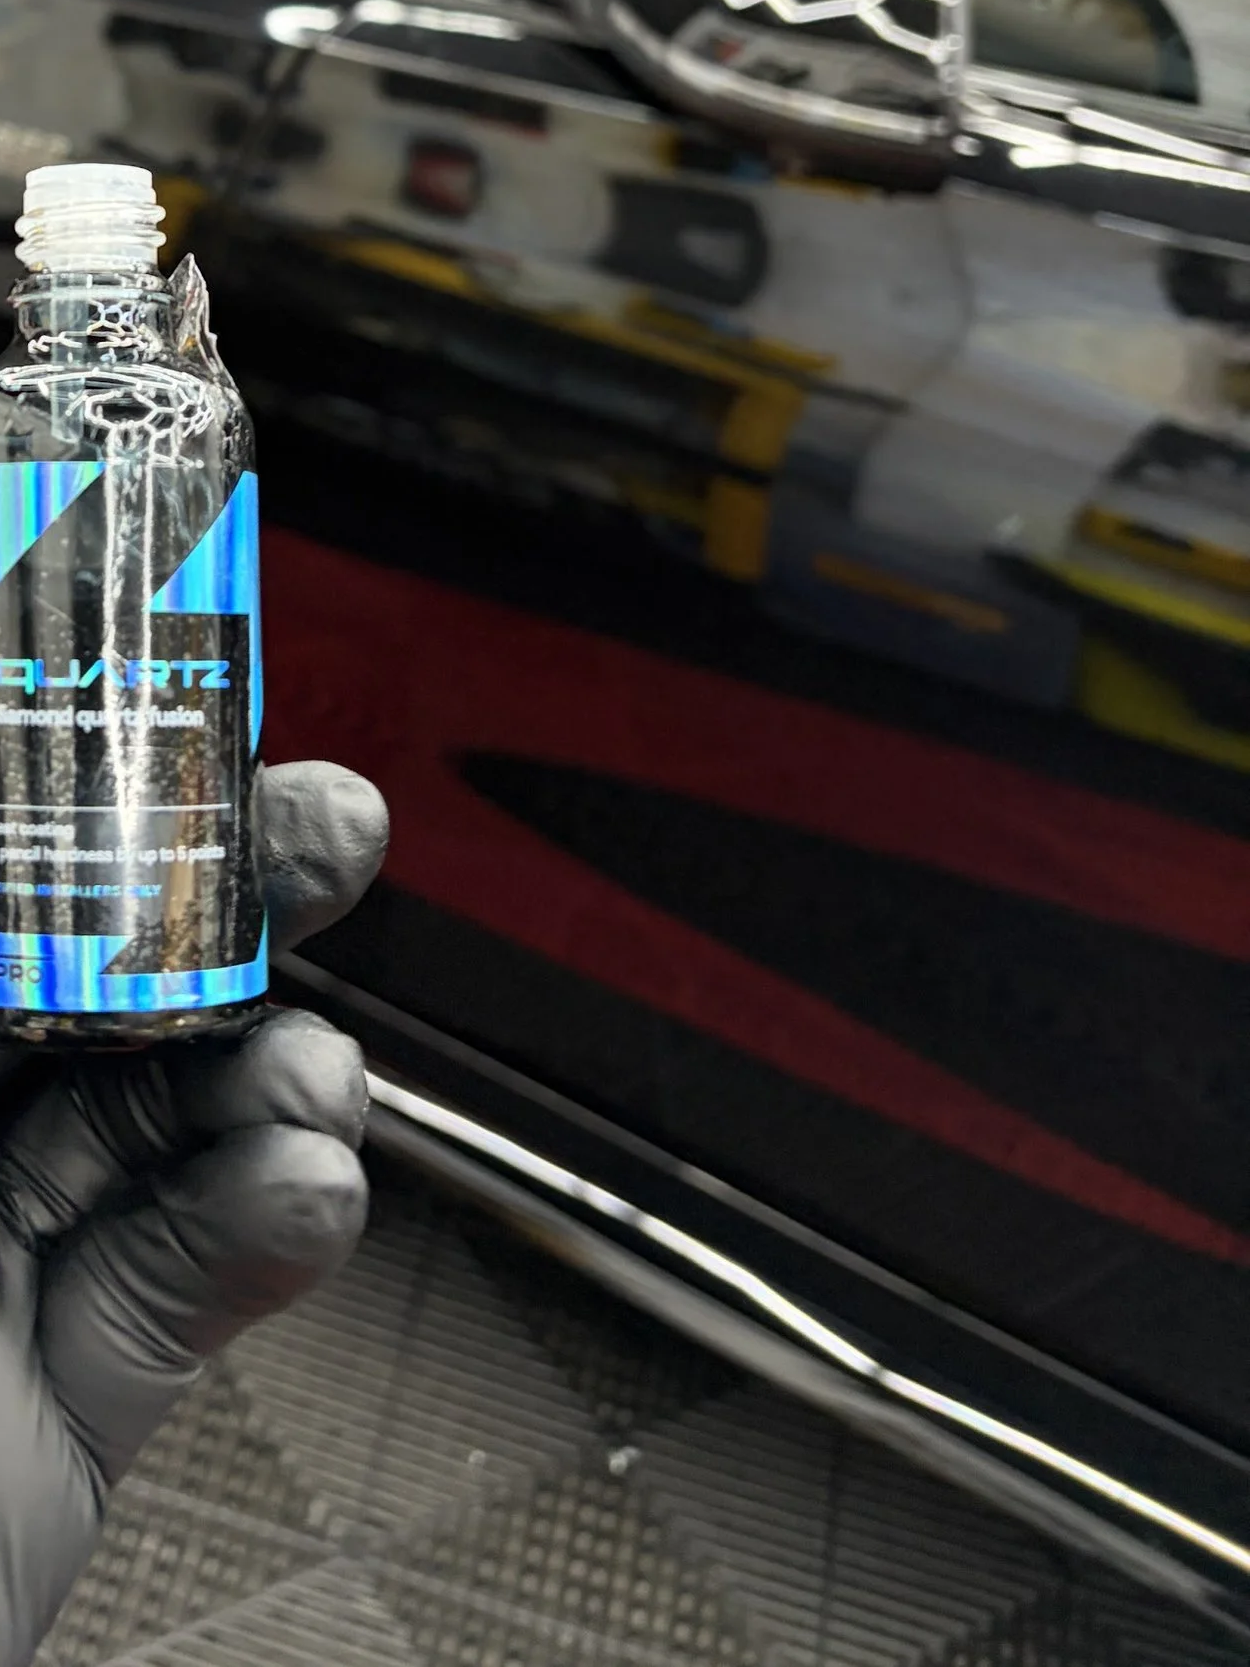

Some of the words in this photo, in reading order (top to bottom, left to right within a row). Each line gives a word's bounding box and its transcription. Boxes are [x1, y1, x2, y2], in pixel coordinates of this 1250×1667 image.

[148, 705, 205, 728] fusion
[0, 845, 41, 865] pencil
[44, 845, 113, 864] hardness
[138, 849, 158, 867] up
[159, 847, 175, 863] to
